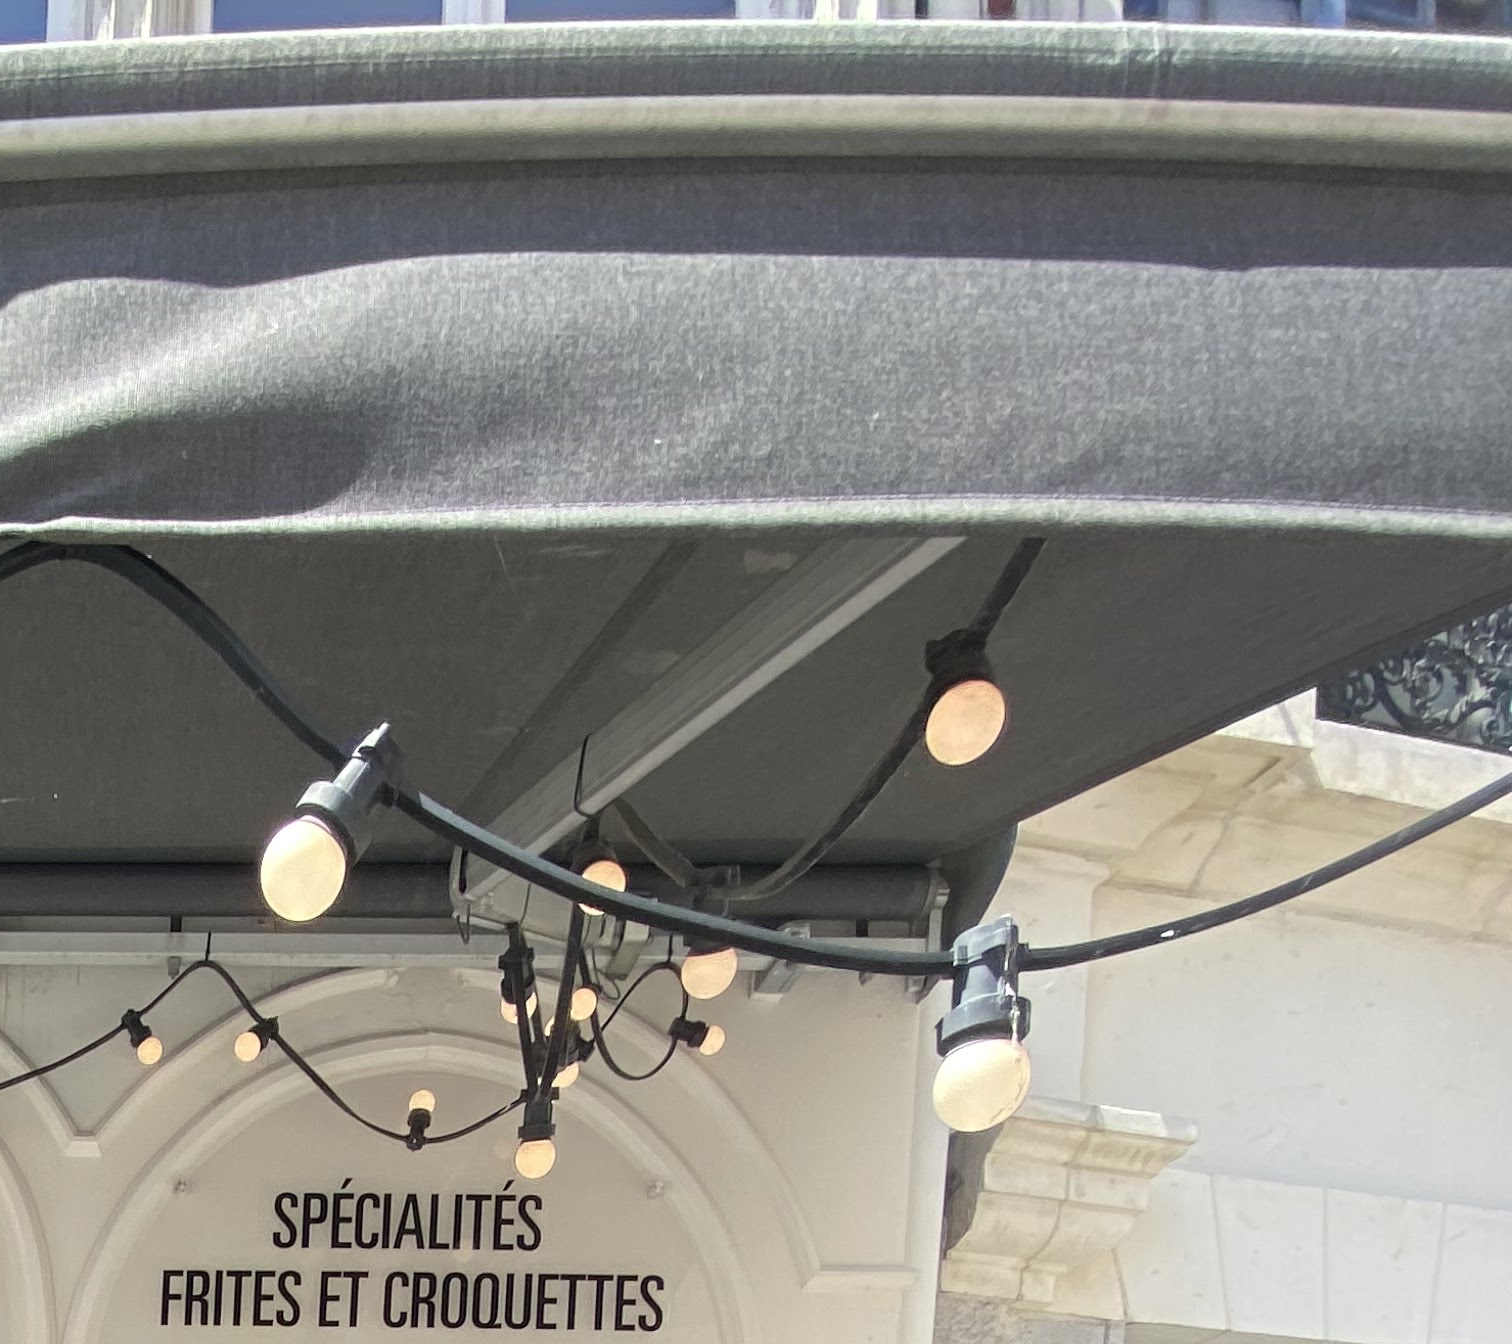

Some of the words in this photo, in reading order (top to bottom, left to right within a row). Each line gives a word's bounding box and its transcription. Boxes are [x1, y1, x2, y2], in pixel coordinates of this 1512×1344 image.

[272, 1177, 544, 1251] SPÉCIALITÉS
[159, 1268, 301, 1328] FRITES
[317, 1270, 369, 1328] ET
[382, 1271, 666, 1333] CROQUETTES
